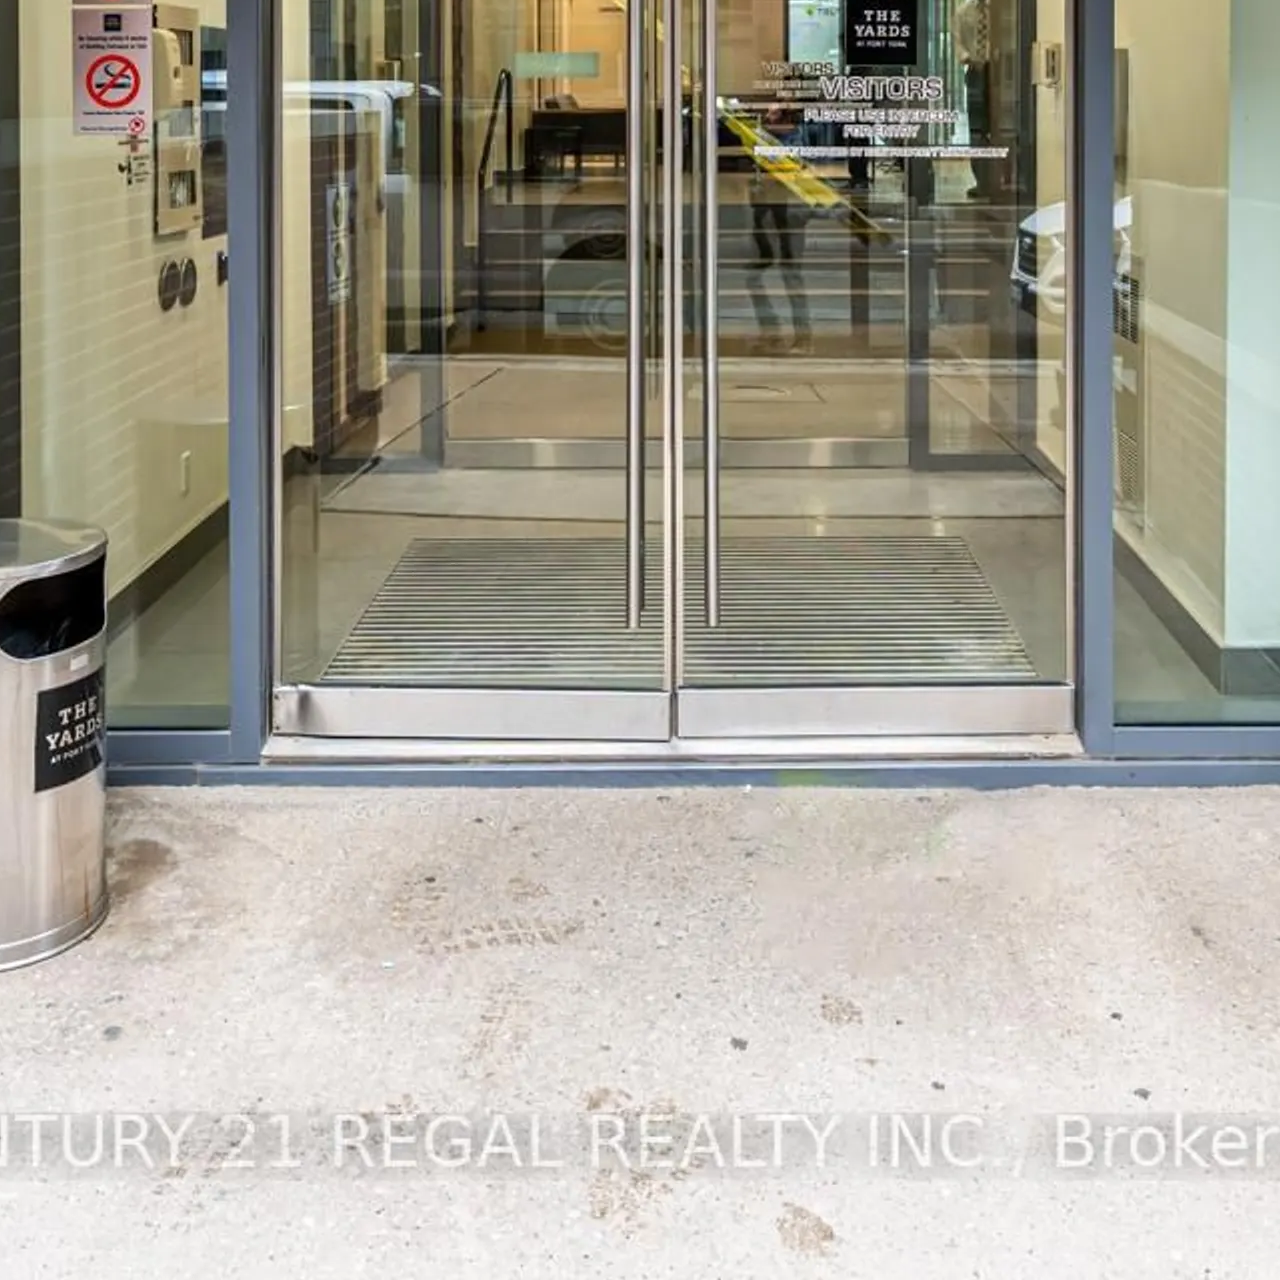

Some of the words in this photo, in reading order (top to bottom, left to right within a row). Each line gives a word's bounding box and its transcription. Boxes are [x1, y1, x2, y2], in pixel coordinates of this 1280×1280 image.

[864, 10, 901, 22] THE
[854, 24, 911, 37] YARDS
[821, 76, 944, 100] VISITORS
[804, 108, 856, 123] PLEASE
[858, 108, 885, 123] USE
[871, 124, 921, 139] ENTRY
[58, 696, 98, 725] THE
[45, 712, 104, 751] YARDS
